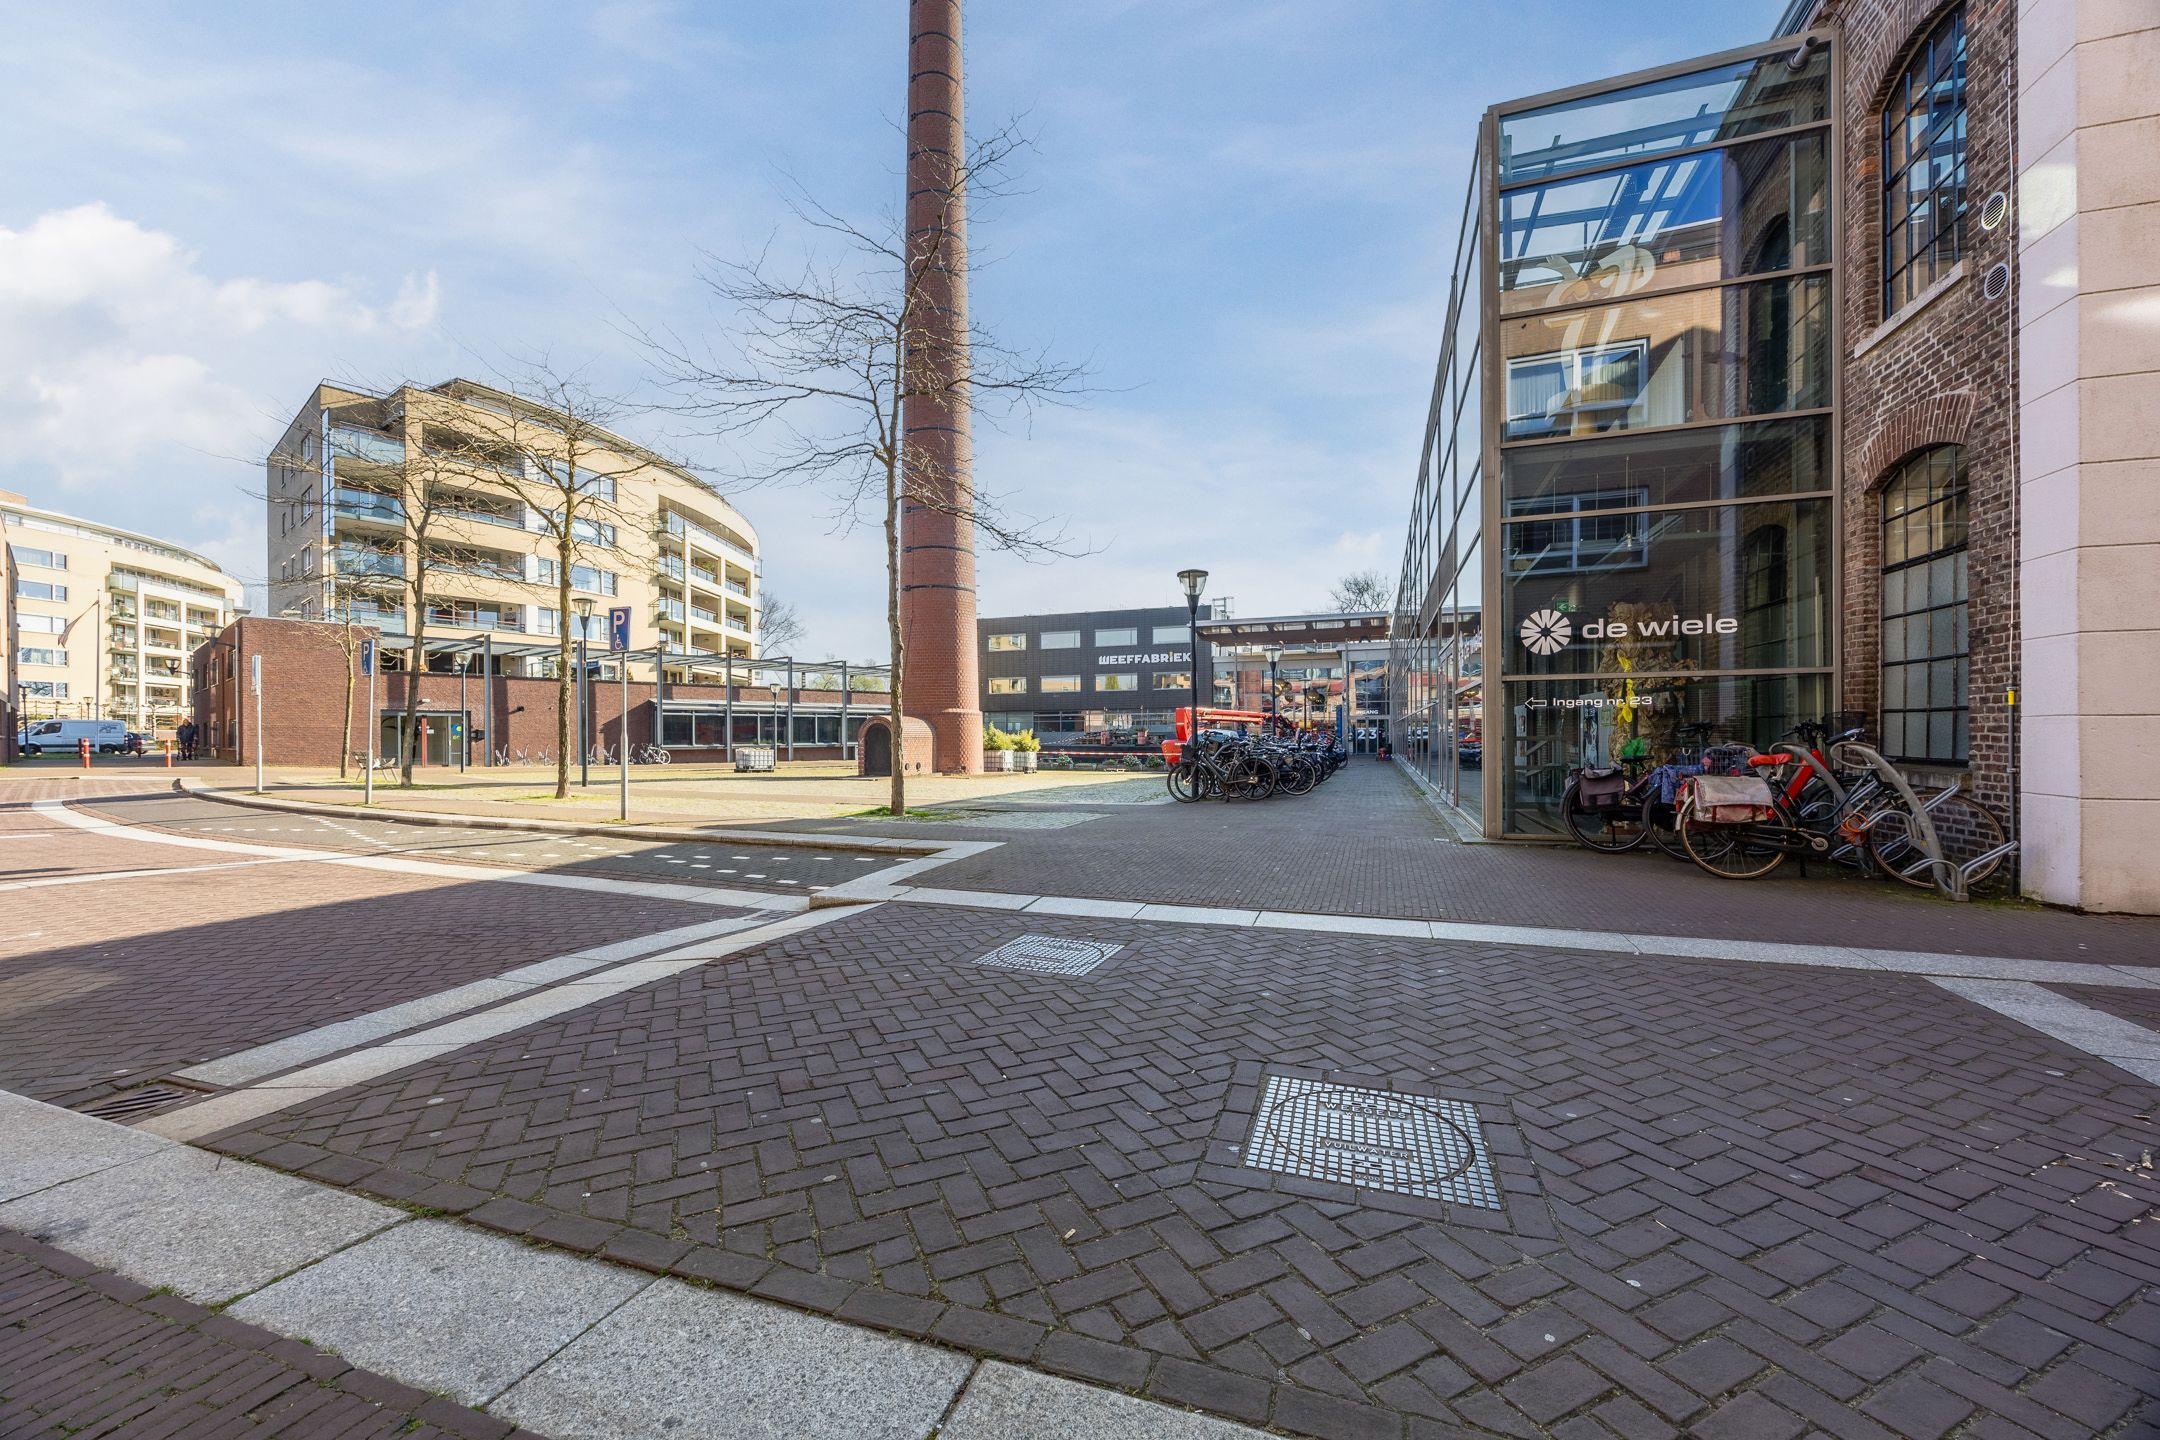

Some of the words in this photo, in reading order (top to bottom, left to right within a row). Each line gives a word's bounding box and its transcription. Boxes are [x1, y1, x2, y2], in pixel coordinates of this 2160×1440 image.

[613, 610, 625, 634] P
[1581, 618, 1628, 639] de
[1636, 613, 1738, 636] wiele
[363, 643, 370, 661] P
[1552, 697, 1604, 708] Ingang
[1628, 695, 1653, 705] 23
[1357, 729, 1378, 740] 23
[1325, 1102, 1407, 1119] WEEGELS
[1324, 1140, 1409, 1159] VUILWATER
